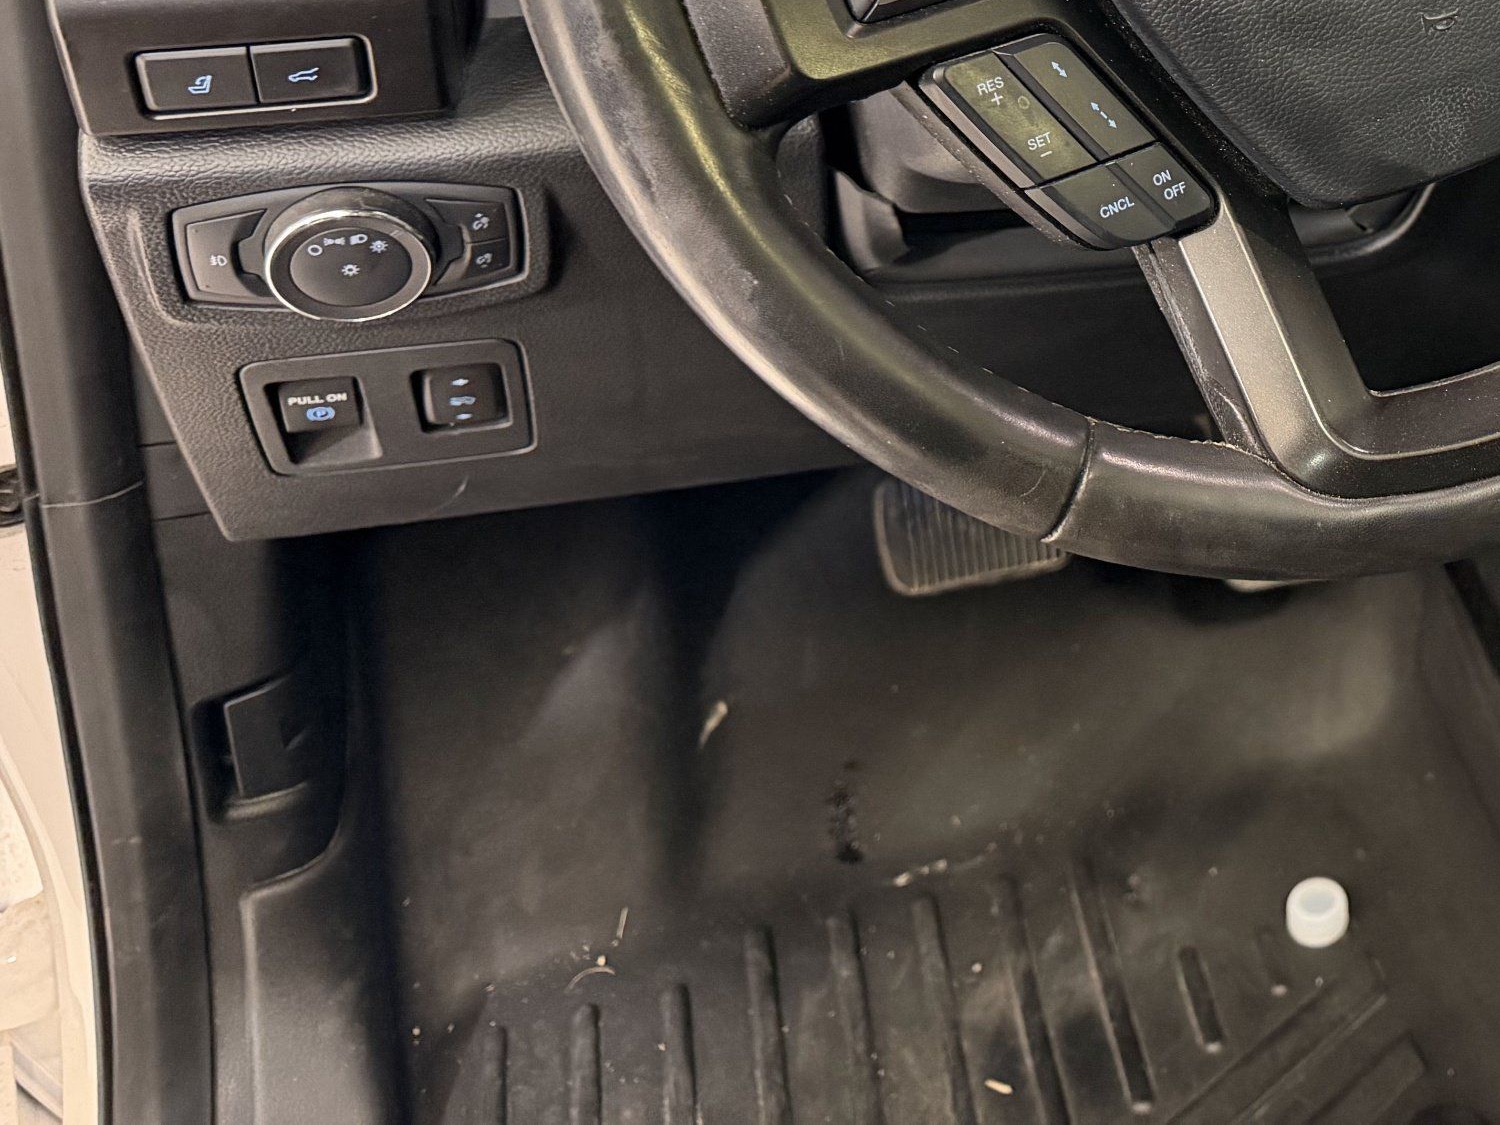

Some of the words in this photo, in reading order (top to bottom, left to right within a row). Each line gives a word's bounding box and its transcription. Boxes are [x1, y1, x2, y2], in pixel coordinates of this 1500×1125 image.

[976, 76, 1004, 97] RES
[1027, 132, 1051, 151] SET
[1152, 169, 1172, 187] ON
[1163, 181, 1187, 201] OFF
[1099, 195, 1135, 219] CNCL
[287, 395, 325, 406] PULL
[326, 392, 348, 403] ON
